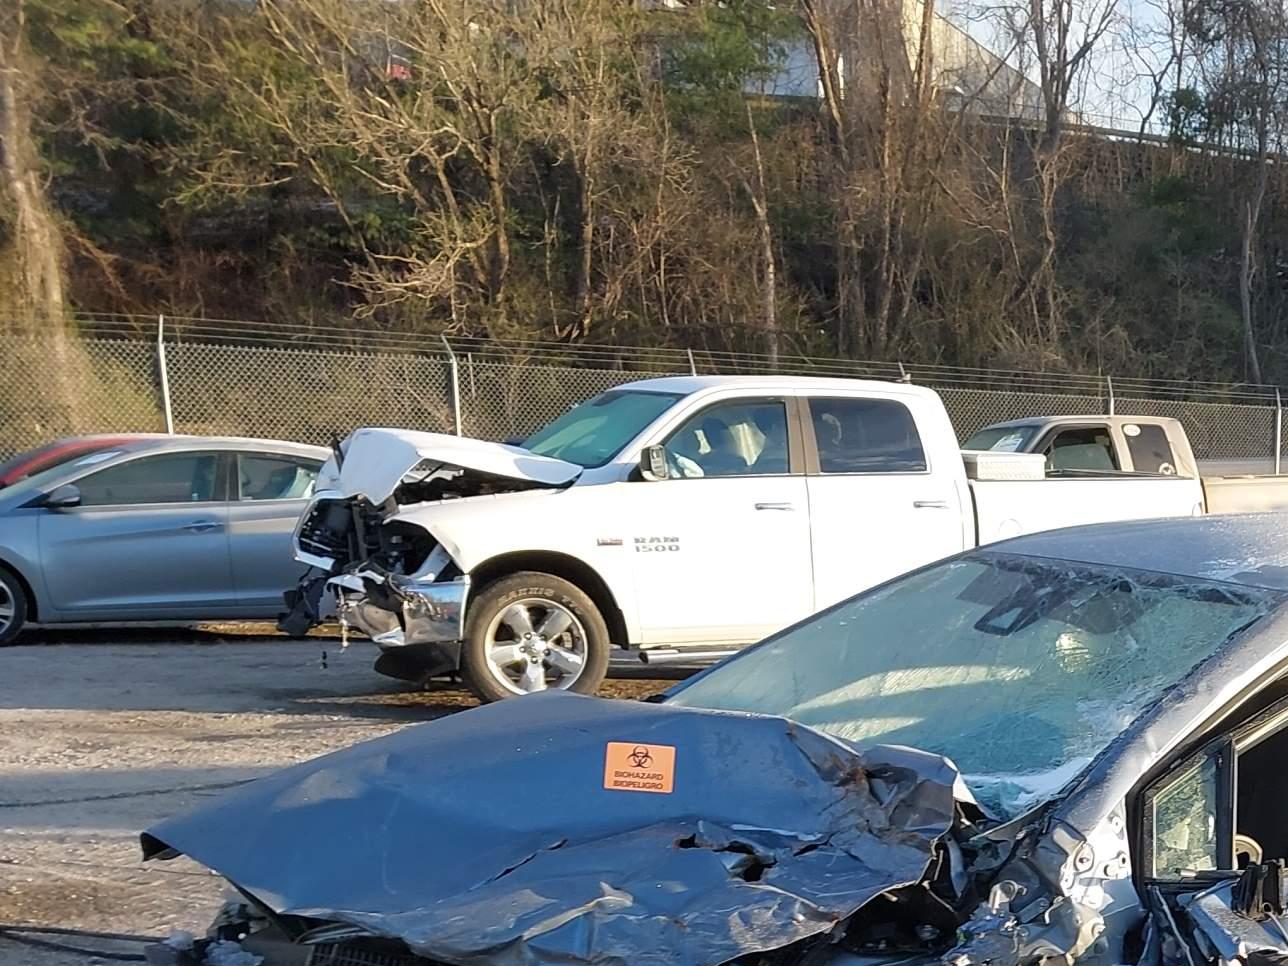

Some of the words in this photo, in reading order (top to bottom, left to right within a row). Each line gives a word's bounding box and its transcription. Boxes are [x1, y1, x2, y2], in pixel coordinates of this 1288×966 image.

[634, 536, 680, 544] RAM
[635, 544, 680, 553] 1500
[614, 770, 664, 781] BIOHAZARD
[613, 780, 664, 790] BIOPELIGRO
